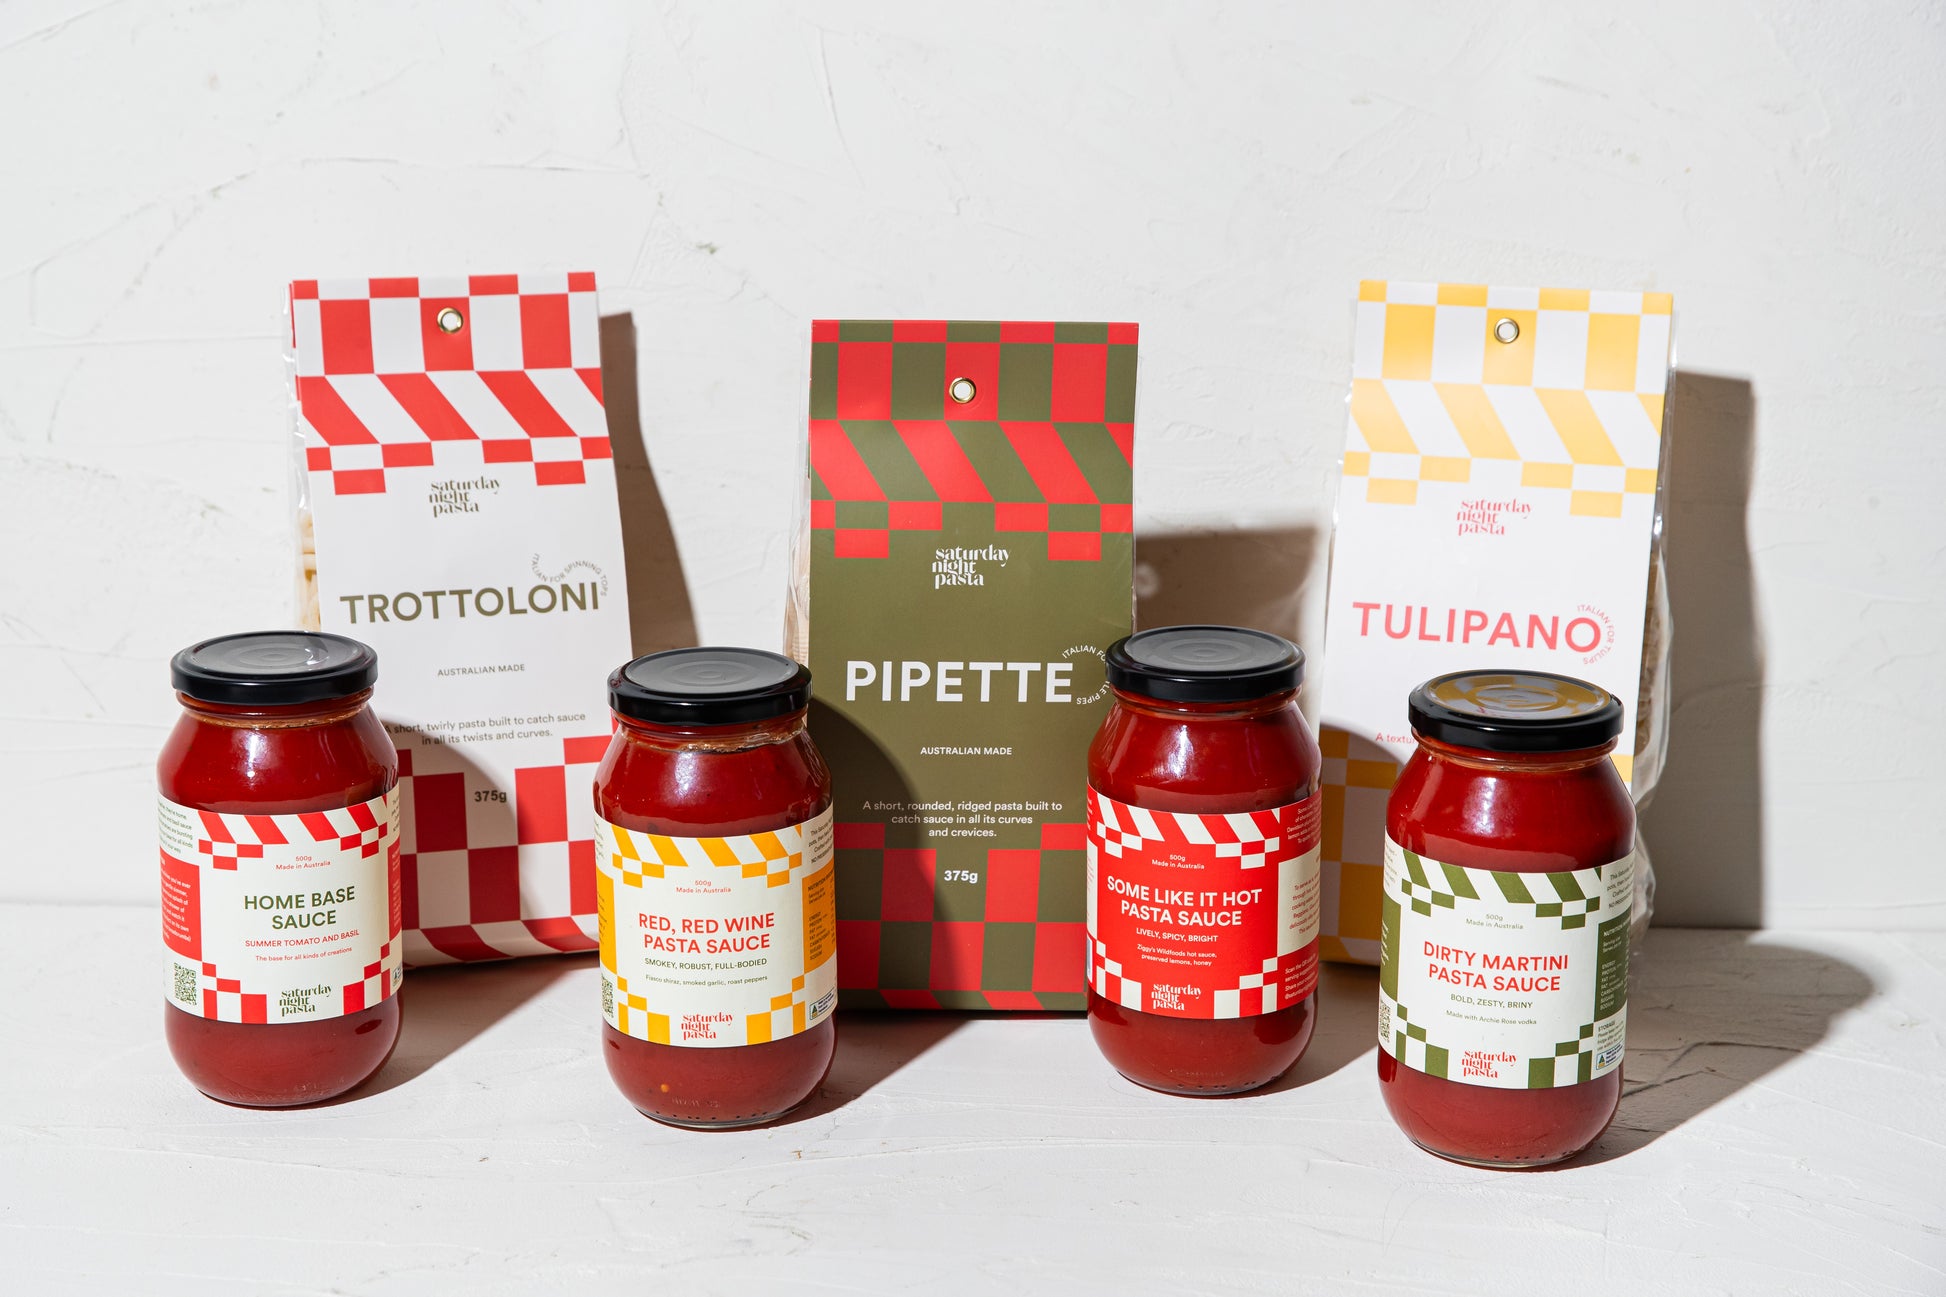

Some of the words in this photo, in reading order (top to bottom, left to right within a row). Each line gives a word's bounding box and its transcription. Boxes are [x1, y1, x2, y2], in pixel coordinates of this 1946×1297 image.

[431, 476, 500, 495] saturday
[429, 491, 469, 504] night
[433, 501, 479, 517] pasta
[1460, 498, 1532, 519] saturday
[1456, 510, 1499, 524] night
[1458, 522, 1505, 536] pasta
[936, 544, 1011, 567] saturday
[932, 560, 976, 576] night
[935, 573, 984, 589] pasta
[340, 582, 599, 624] TROTTOLONI
[1577, 604, 1610, 624] ITALIAN
[1353, 601, 1601, 653] TULIPANO
[1606, 624, 1615, 643] FOR
[1062, 645, 1096, 658] ITALIAN
[1583, 646, 1611, 665] TULIPS
[438, 665, 495, 676] AUSTRALIAN
[498, 663, 525, 673] MADE
[846, 660, 1073, 703] PIPETTE
[1077, 693, 1100, 704] PIPES
[394, 724, 424, 733] short,
[427, 721, 456, 731] twirly
[458, 720, 486, 730] pasta
[489, 716, 511, 727] built
[514, 716, 524, 725] to
[527, 714, 554, 724] catch
[558, 713, 586, 722] sauce
[422, 736, 432, 745] in
[434, 735, 445, 744] all
[449, 734, 460, 743] its
[463, 732, 493, 742] twists
[496, 730, 514, 740] and
[517, 729, 553, 739] curves.
[1376, 732, 1383, 742] A
[920, 746, 981, 755] AUSTRALIAN
[983, 746, 1012, 755] MADE
[474, 790, 507, 802] 375g
[863, 801, 871, 811] A
[874, 801, 904, 812] short,
[907, 801, 954, 812] rounded,
[957, 801, 992, 814] ridged
[994, 802, 1022, 813] pasta
[1025, 801, 1049, 811] built
[1051, 802, 1062, 811] to
[892, 814, 921, 824] catch
[923, 815, 954, 824] sauce
[956, 814, 966, 824] in
[968, 814, 981, 824] all
[983, 814, 996, 824] its
[998, 816, 1032, 824] curves
[928, 828, 949, 837] and
[951, 828, 997, 837] crevices.
[1152, 859, 1168, 867] Made
[1177, 862, 1205, 870] Australia
[1169, 854, 1186, 862] 500g
[944, 870, 978, 884] 375g
[702, 886, 732, 894] Australia
[1107, 875, 1150, 900] SOME
[1154, 887, 1194, 907] LIKE
[1200, 891, 1217, 907] IT
[1222, 889, 1262, 906] HOT
[244, 894, 305, 910] HOME
[311, 886, 355, 907] BASE
[272, 910, 336, 930] SAUCE
[1121, 901, 1173, 924] PASTA
[1178, 910, 1242, 926] SAUCE
[1486, 914, 1504, 922] 500g
[639, 912, 676, 935] RED,
[682, 918, 719, 934] RED
[724, 912, 775, 932] WINE
[1466, 918, 1484, 926] Made
[1494, 922, 1524, 930] Australia
[285, 936, 320, 946] TOMATO
[322, 934, 339, 943] AND
[340, 929, 359, 940] BASIL
[1136, 928, 1161, 940] LIVELY,
[1162, 932, 1186, 943] SPICY,
[1188, 934, 1218, 943] BRIGHT
[644, 934, 701, 954] PASTA
[706, 934, 770, 953] SAUCE
[1137, 944, 1156, 953] Ziggy's
[1157, 947, 1185, 957] Wildfoods
[328, 946, 352, 957] creations
[1424, 940, 1476, 966] DIRTY
[1482, 954, 1569, 971] MARTINI
[644, 958, 677, 970] SMOKEY,
[679, 962, 713, 971] ROBUST,
[715, 958, 768, 970] FULL-BODIED
[1142, 953, 1168, 964] preserved
[1170, 958, 1192, 966] lemons,
[1194, 959, 1212, 967] honey
[646, 974, 662, 983] Fiasco
[663, 977, 680, 986] shiraz,
[707, 979, 726, 987] garlic,
[728, 978, 743, 986] roast
[744, 975, 768, 985] peppers
[1429, 964, 1487, 989] PASTA
[1493, 976, 1561, 992] SAUCE
[281, 984, 332, 998] saturday
[1151, 990, 1180, 1003] night
[1154, 983, 1202, 999] saturday
[279, 995, 310, 1007] night
[1153, 999, 1184, 1011] pasta
[1450, 994, 1475, 1006] BOLD,
[1477, 998, 1505, 1009] ZESTY,
[1507, 1001, 1533, 1009] BRINY
[281, 1003, 316, 1017] pasta
[1446, 1009, 1463, 1019] Made
[1464, 1013, 1478, 1021] with
[1479, 1015, 1500, 1024] Archie
[1501, 1017, 1516, 1025] Rose
[683, 1011, 734, 1026] saturday
[681, 1022, 710, 1032] night
[683, 1029, 717, 1041] pasta
[1462, 1058, 1493, 1070] night
[1464, 1050, 1517, 1066] saturday
[1463, 1066, 1498, 1078] pasta
